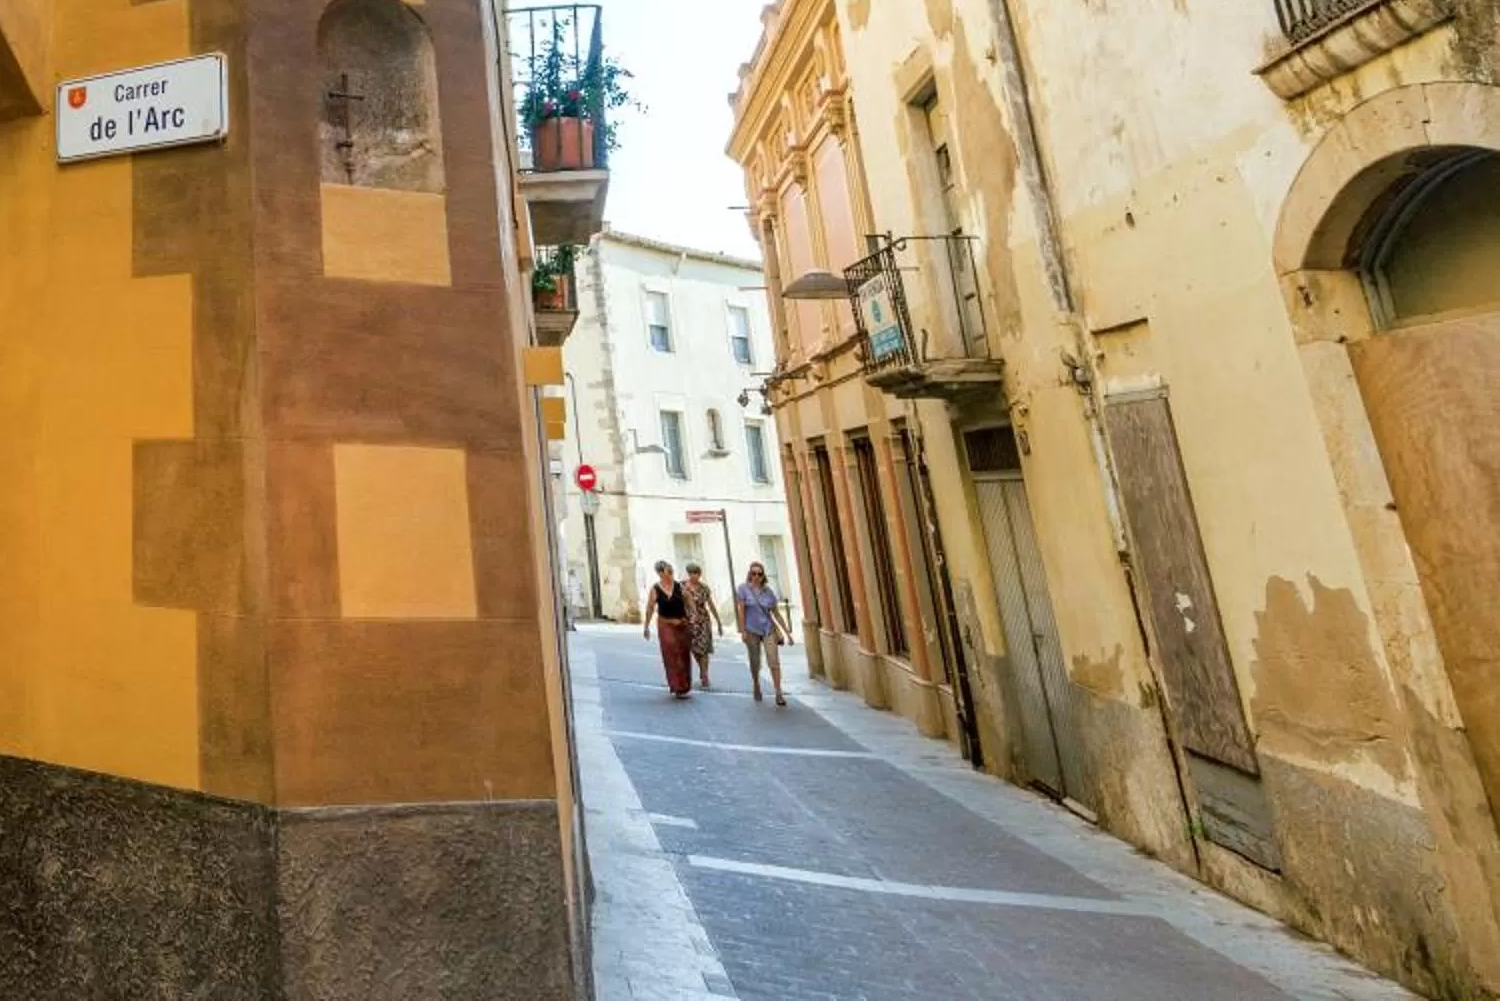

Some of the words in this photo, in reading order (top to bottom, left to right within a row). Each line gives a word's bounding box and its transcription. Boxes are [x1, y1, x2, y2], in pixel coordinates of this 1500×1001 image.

[114, 79, 169, 103] Carrer
[89, 116, 117, 142] de
[128, 106, 186, 136] l'Arc
